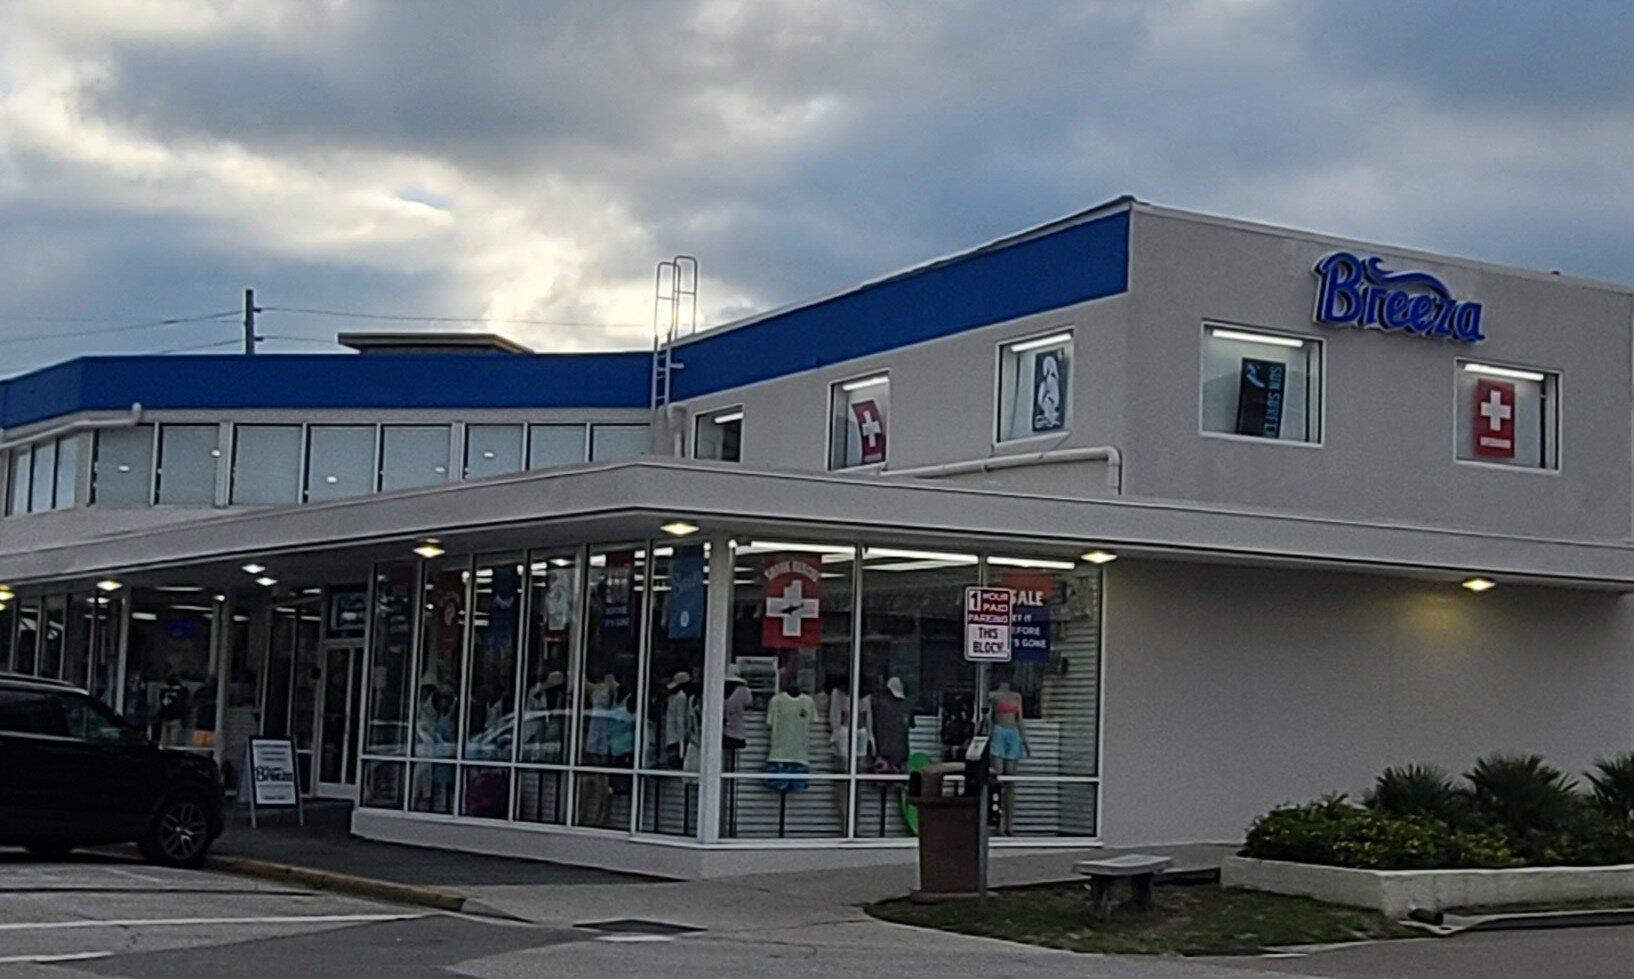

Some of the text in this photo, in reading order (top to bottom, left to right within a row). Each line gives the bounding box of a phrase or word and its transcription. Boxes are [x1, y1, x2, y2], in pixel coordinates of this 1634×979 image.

[1315, 252, 1485, 342] Breeza
[971, 592, 979, 610] 1
[983, 603, 1008, 612] PAID
[978, 627, 998, 639] THIS
[973, 641, 1004, 653] BLOCK
